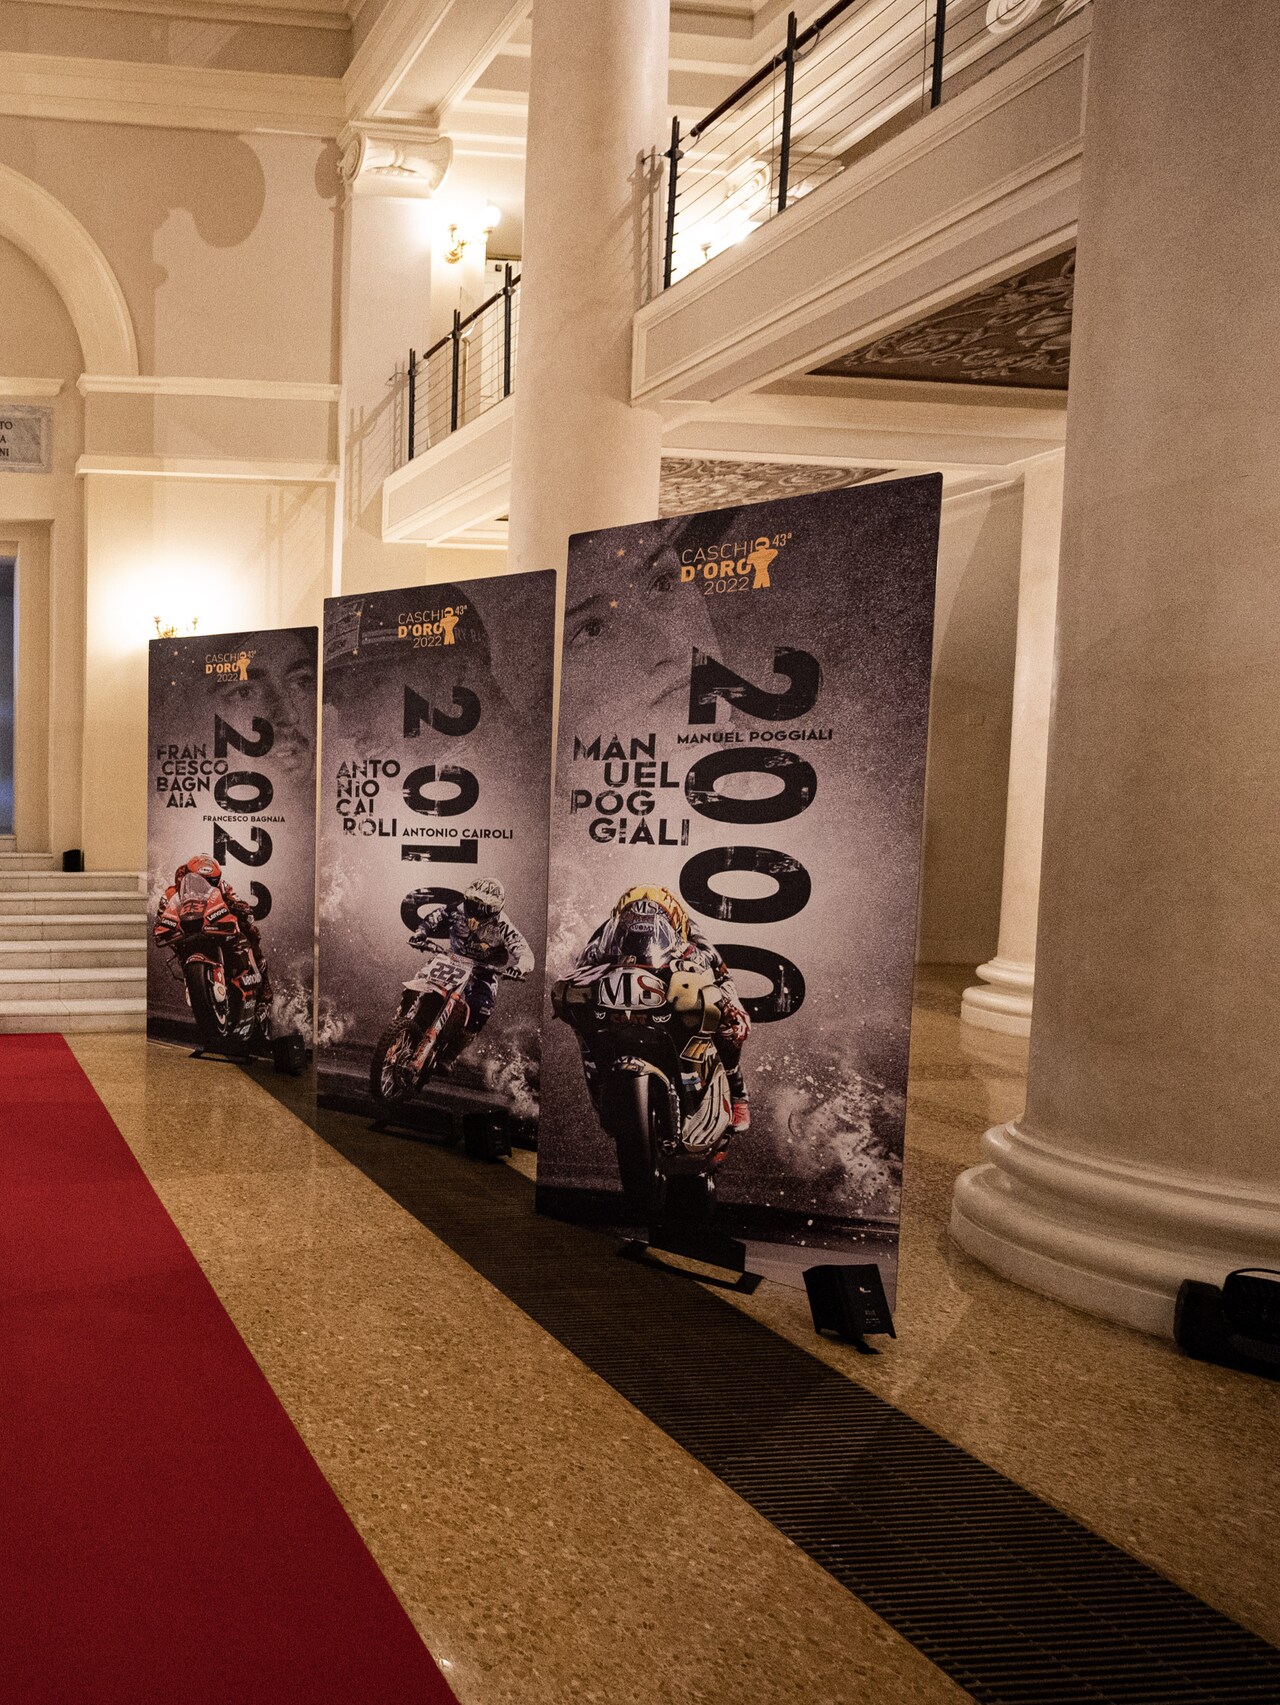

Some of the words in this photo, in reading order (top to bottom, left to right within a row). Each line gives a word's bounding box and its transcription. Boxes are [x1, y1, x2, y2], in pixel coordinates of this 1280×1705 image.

[680, 558, 752, 583] D'ORO
[704, 576, 750, 596] 2022
[397, 623, 443, 639] D'ORO
[412, 635, 442, 649] 2022
[216, 673, 239, 683] 2022
[677, 732, 743, 744] MANUEL
[749, 729, 833, 742] POGGIALI
[156, 743, 207, 760] FRAN
[574, 733, 656, 761] MAN
[161, 759, 229, 775] CESCO
[336, 759, 401, 779] ANTO
[604, 761, 680, 788] UEL
[156, 776, 210, 792] BAGN
[337, 779, 380, 798] NIO
[166, 793, 197, 808] AIA
[336, 799, 374, 816] CAI
[571, 789, 656, 816] POG
[251, 815, 286, 823] BAGNAIA
[343, 818, 397, 837] ROLI
[402, 828, 458, 838] ANTONIO
[462, 828, 513, 840] CAIROLI
[589, 817, 690, 846] GIALI
[161, 917, 178, 928] Lenovo
[206, 907, 228, 922] Lenovo
[430, 961, 466, 986] 222
